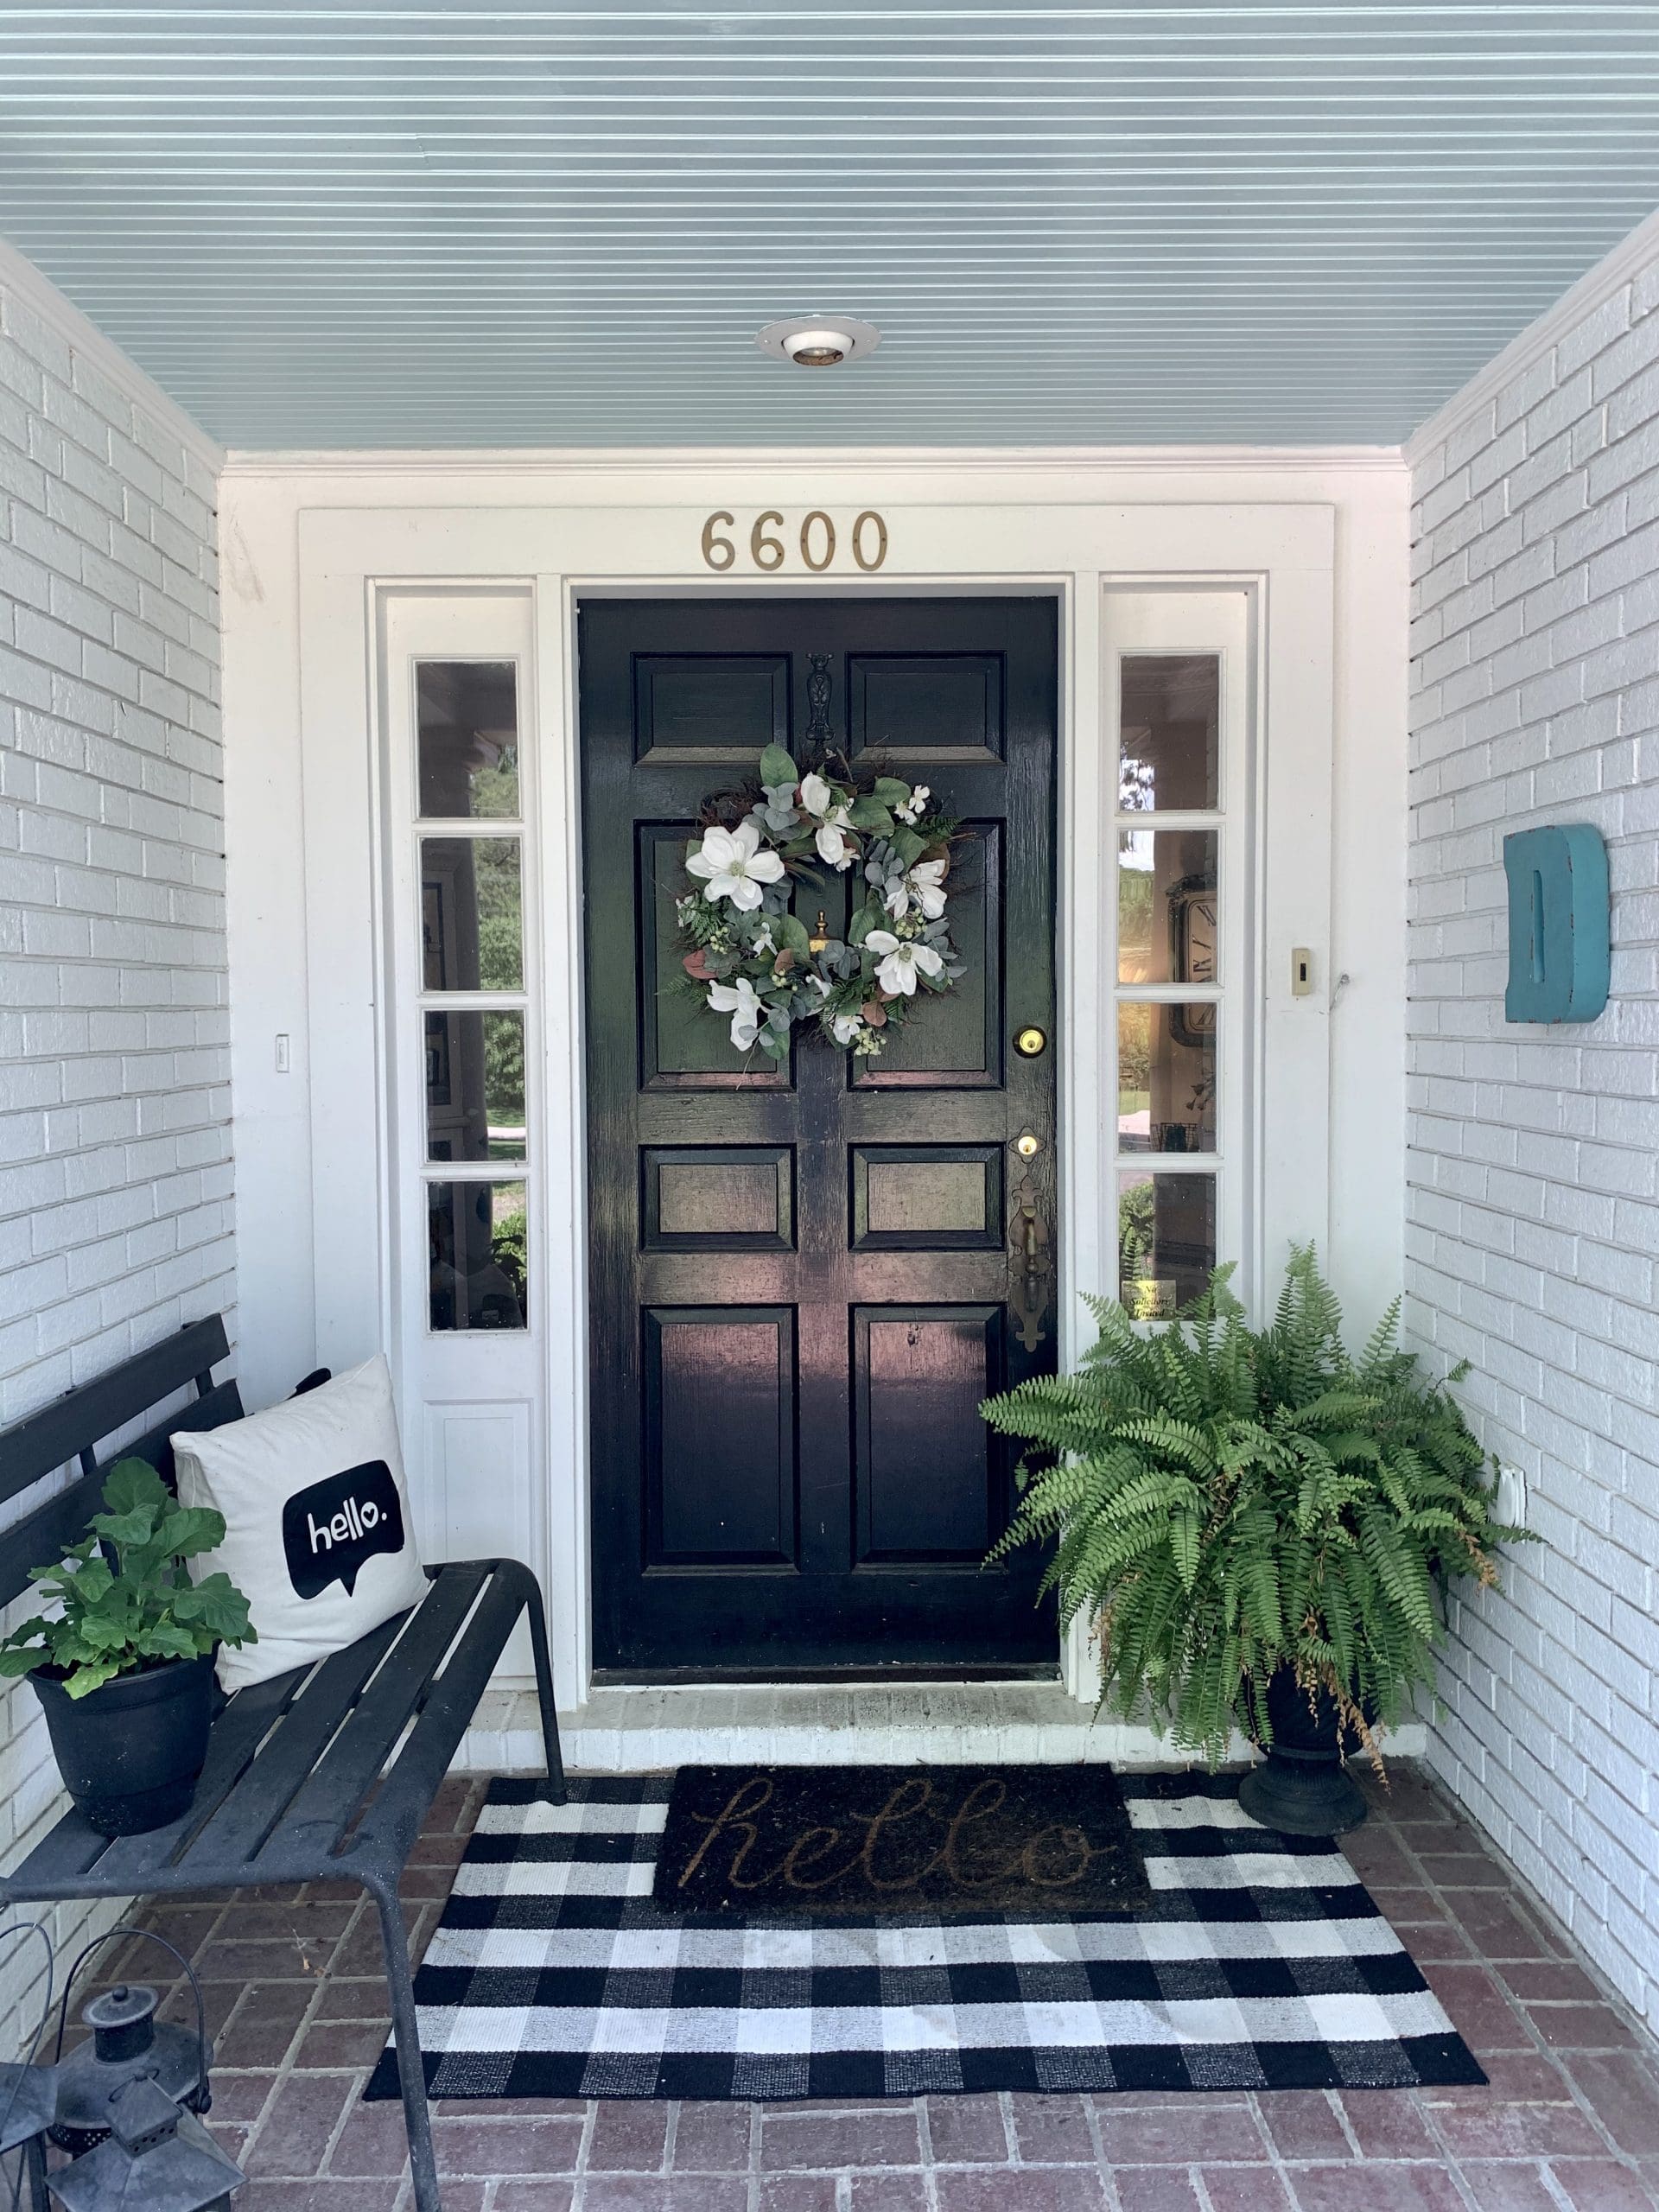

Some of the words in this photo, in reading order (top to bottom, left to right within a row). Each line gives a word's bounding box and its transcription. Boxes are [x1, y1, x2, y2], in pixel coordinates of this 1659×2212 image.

[701, 510, 888, 572] 6600
[1503, 823, 1611, 1024] D
[1130, 1297, 1168, 1306] Solicitors
[677, 1777, 1119, 1889] hello
